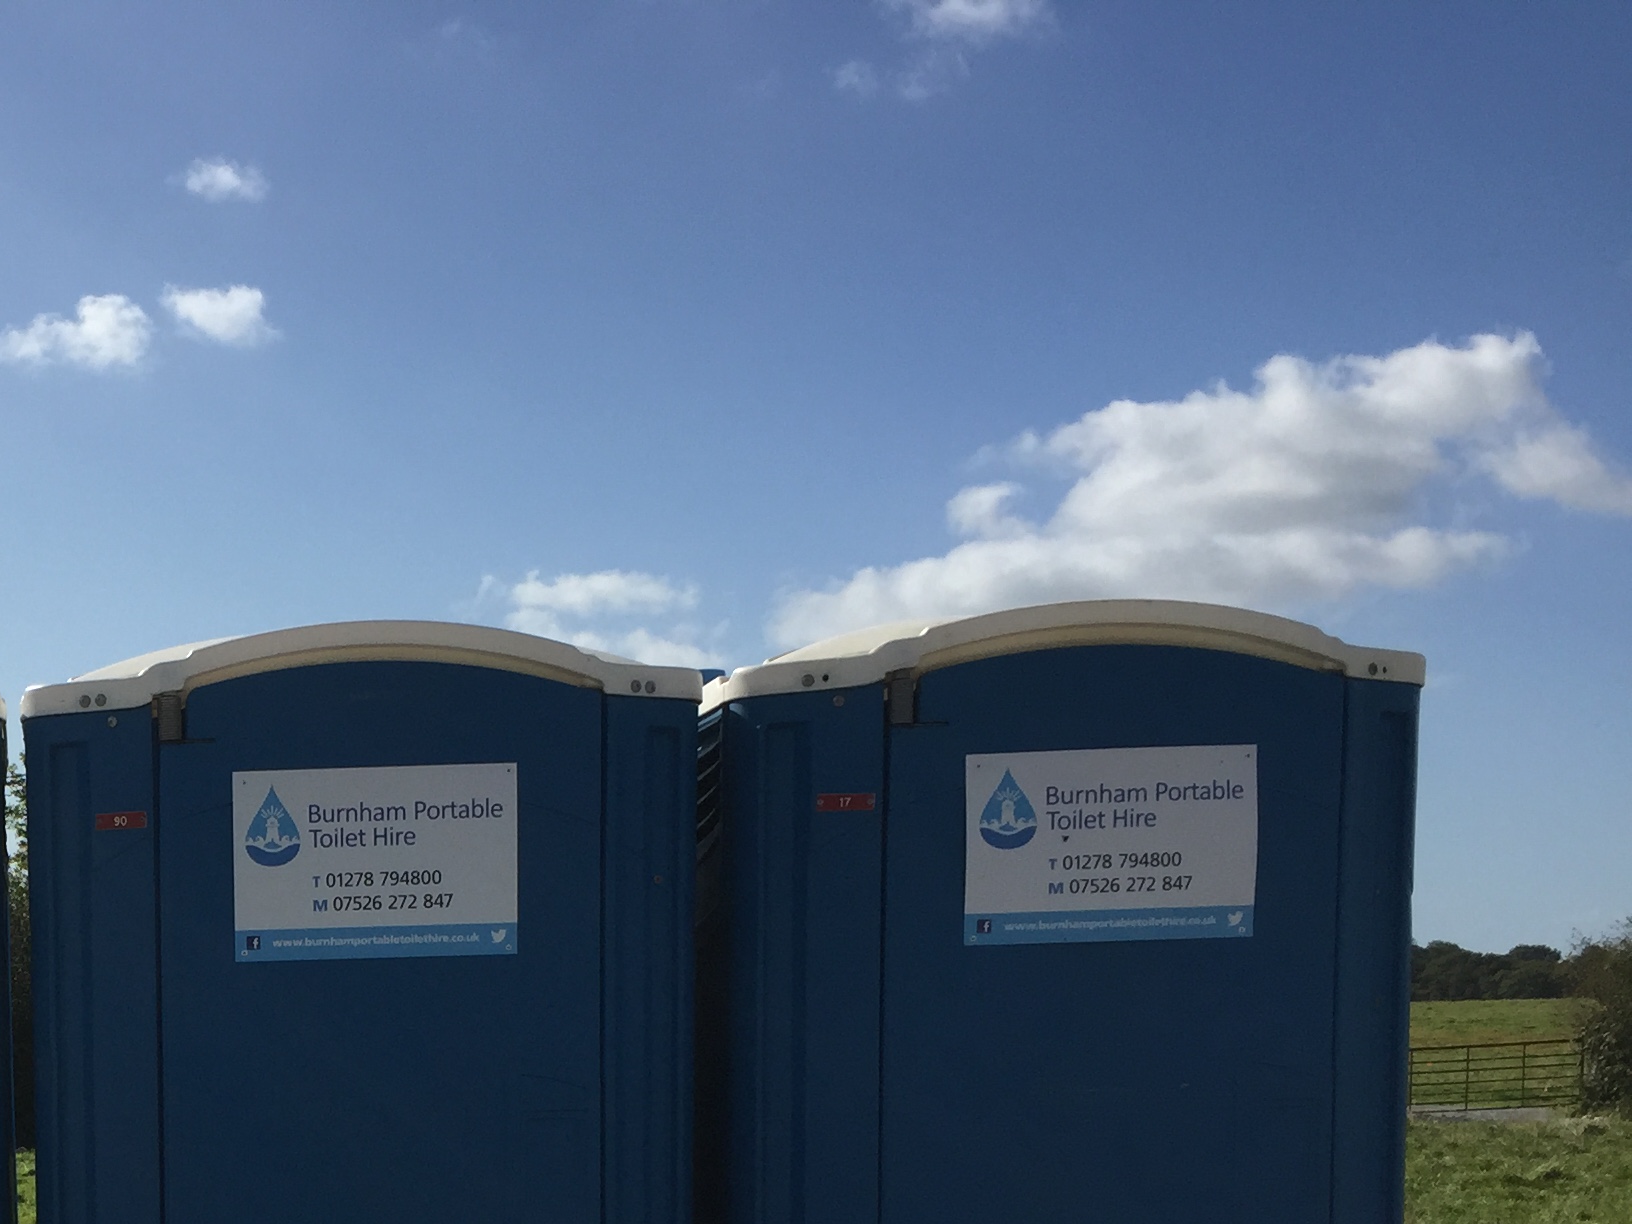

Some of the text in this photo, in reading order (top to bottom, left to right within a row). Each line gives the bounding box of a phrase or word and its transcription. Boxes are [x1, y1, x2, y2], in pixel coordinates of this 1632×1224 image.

[1046, 780, 1244, 805] Burnham Portable
[308, 798, 503, 823] Burnham Portable
[839, 797, 851, 807] 17
[114, 816, 127, 826] 90
[1046, 808, 1156, 830] Toilet Hire
[309, 827, 416, 848] Toilet Hire
[1049, 852, 1182, 870] T 01278 794800
[313, 870, 441, 888] T 01278 794800
[1049, 876, 1192, 894] M 07526 272 847
[313, 894, 453, 911] M 07526 272 847
[1004, 916, 1216, 931] www.burnhamportabletoilethire.co.uk
[272, 933, 479, 948] www.burnhamportabletoilethire.co.uk
